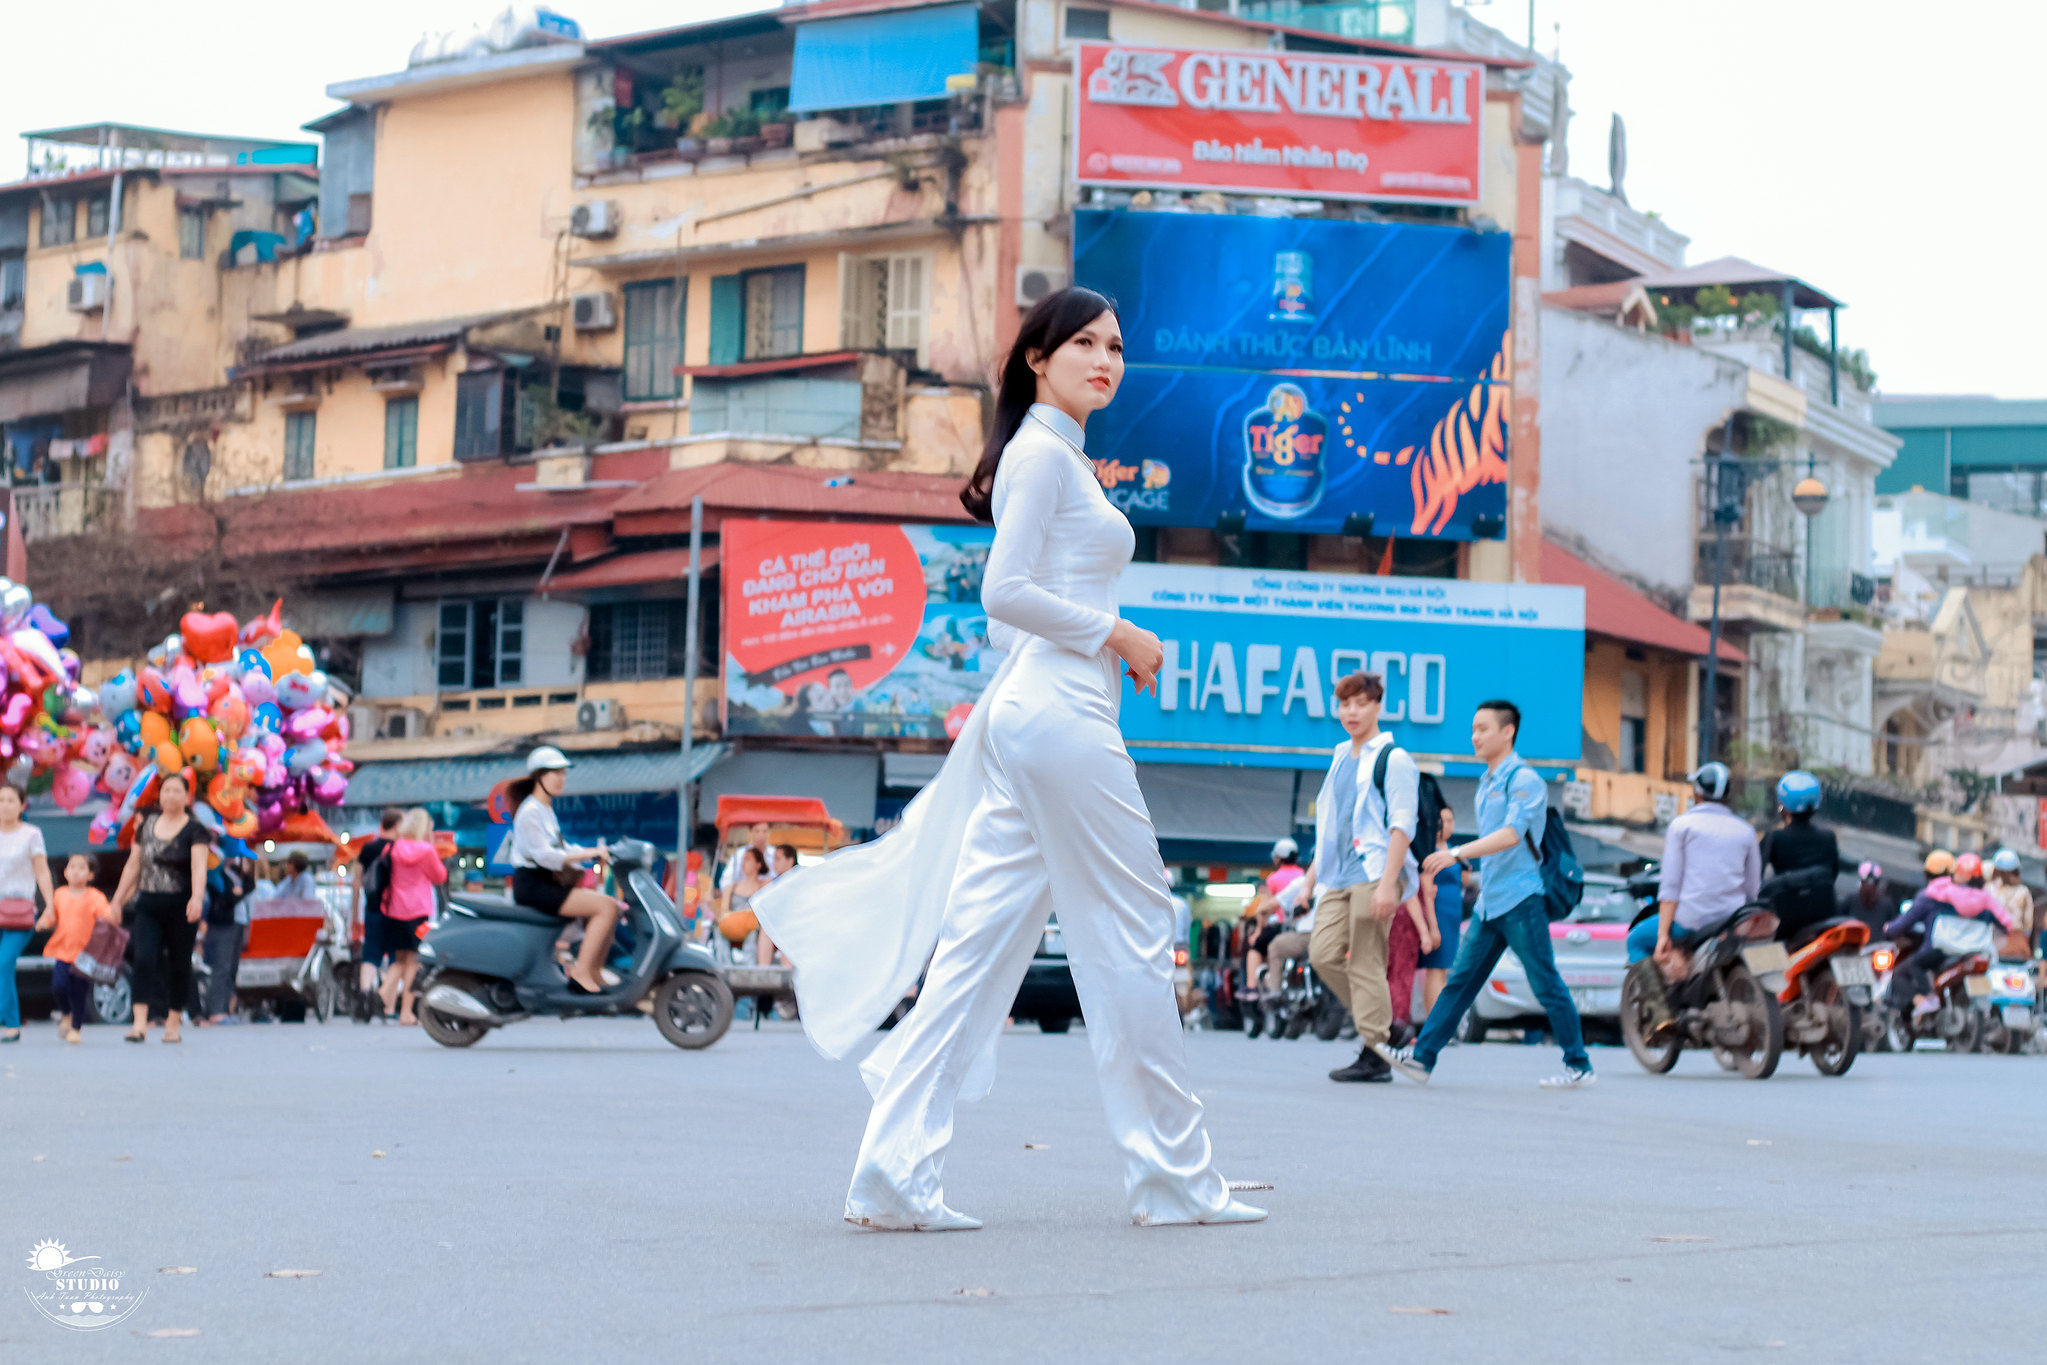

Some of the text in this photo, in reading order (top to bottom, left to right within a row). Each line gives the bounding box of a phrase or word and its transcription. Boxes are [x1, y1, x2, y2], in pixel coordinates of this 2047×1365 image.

[1178, 53, 1472, 124] GENERALI
[1154, 325, 1230, 354] ĐÁNH
[1312, 331, 1368, 360] BẢN
[1249, 423, 1324, 466] Tiger
[780, 600, 862, 629] AIRASIA
